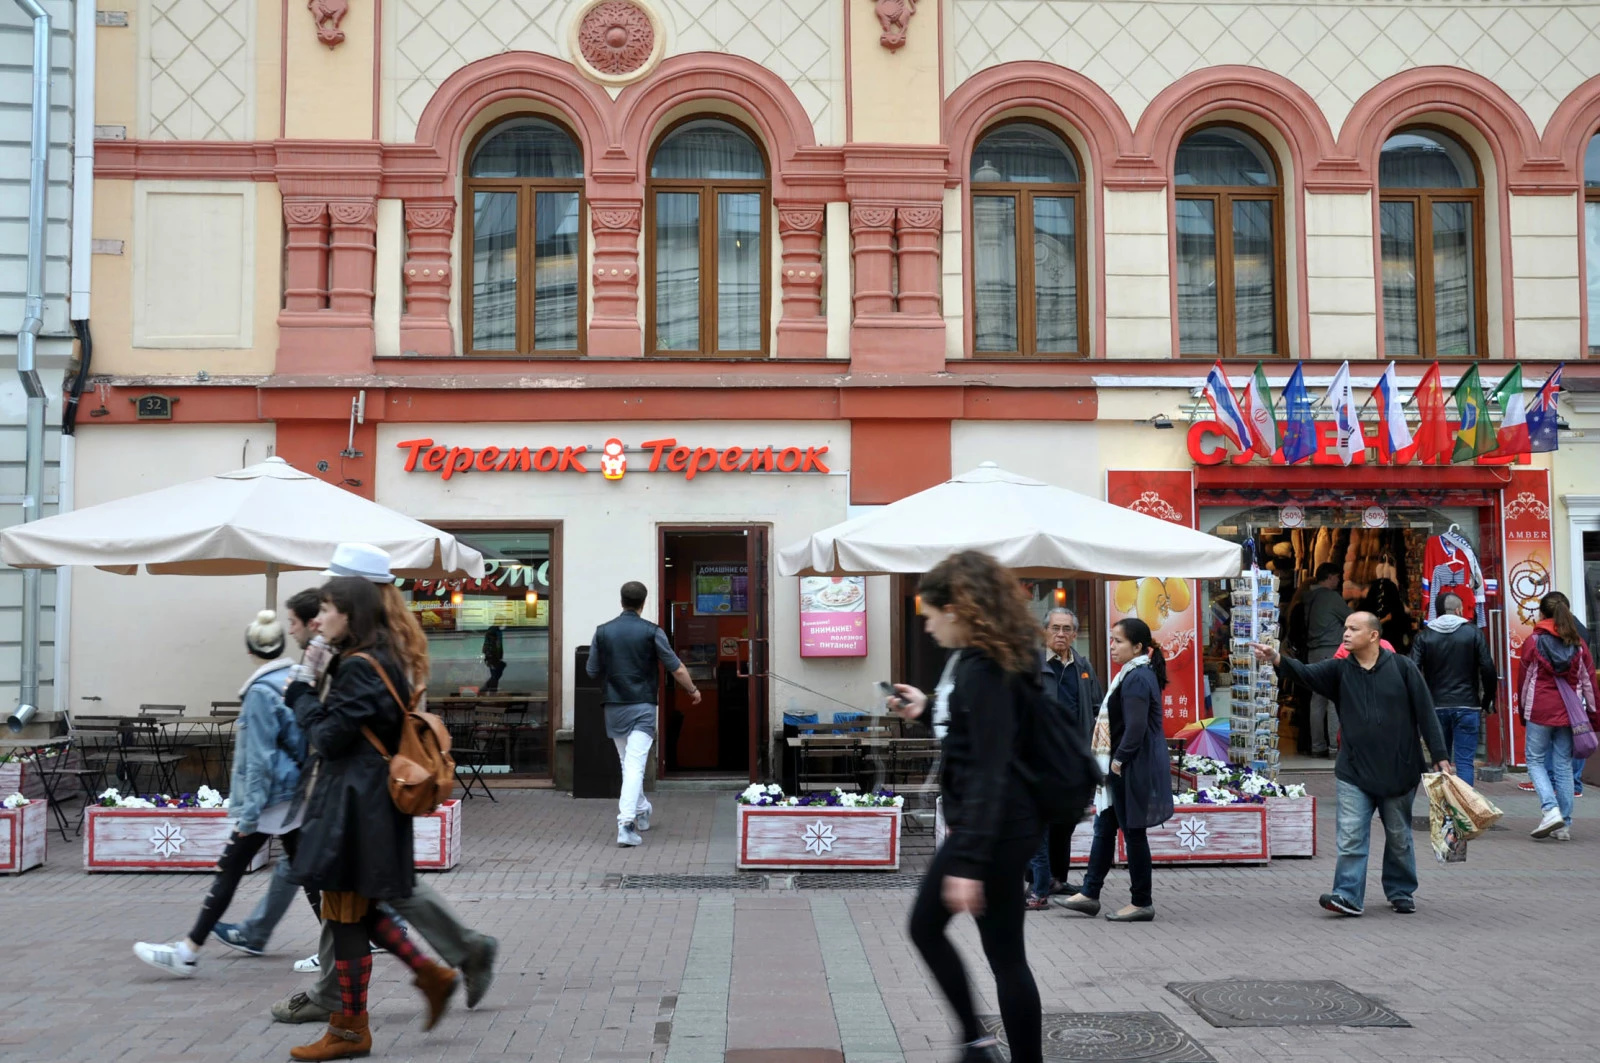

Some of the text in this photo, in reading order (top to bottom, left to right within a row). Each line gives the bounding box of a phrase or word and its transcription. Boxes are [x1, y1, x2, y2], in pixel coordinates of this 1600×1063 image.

[146, 399, 161, 410] 32
[396, 438, 831, 480] Теремок Теремок
[1282, 512, 1302, 520] -50%
[1365, 512, 1385, 520] -50%
[1508, 531, 1548, 539] AMBER
[810, 625, 852, 635] ВНИМАНИЕ!
